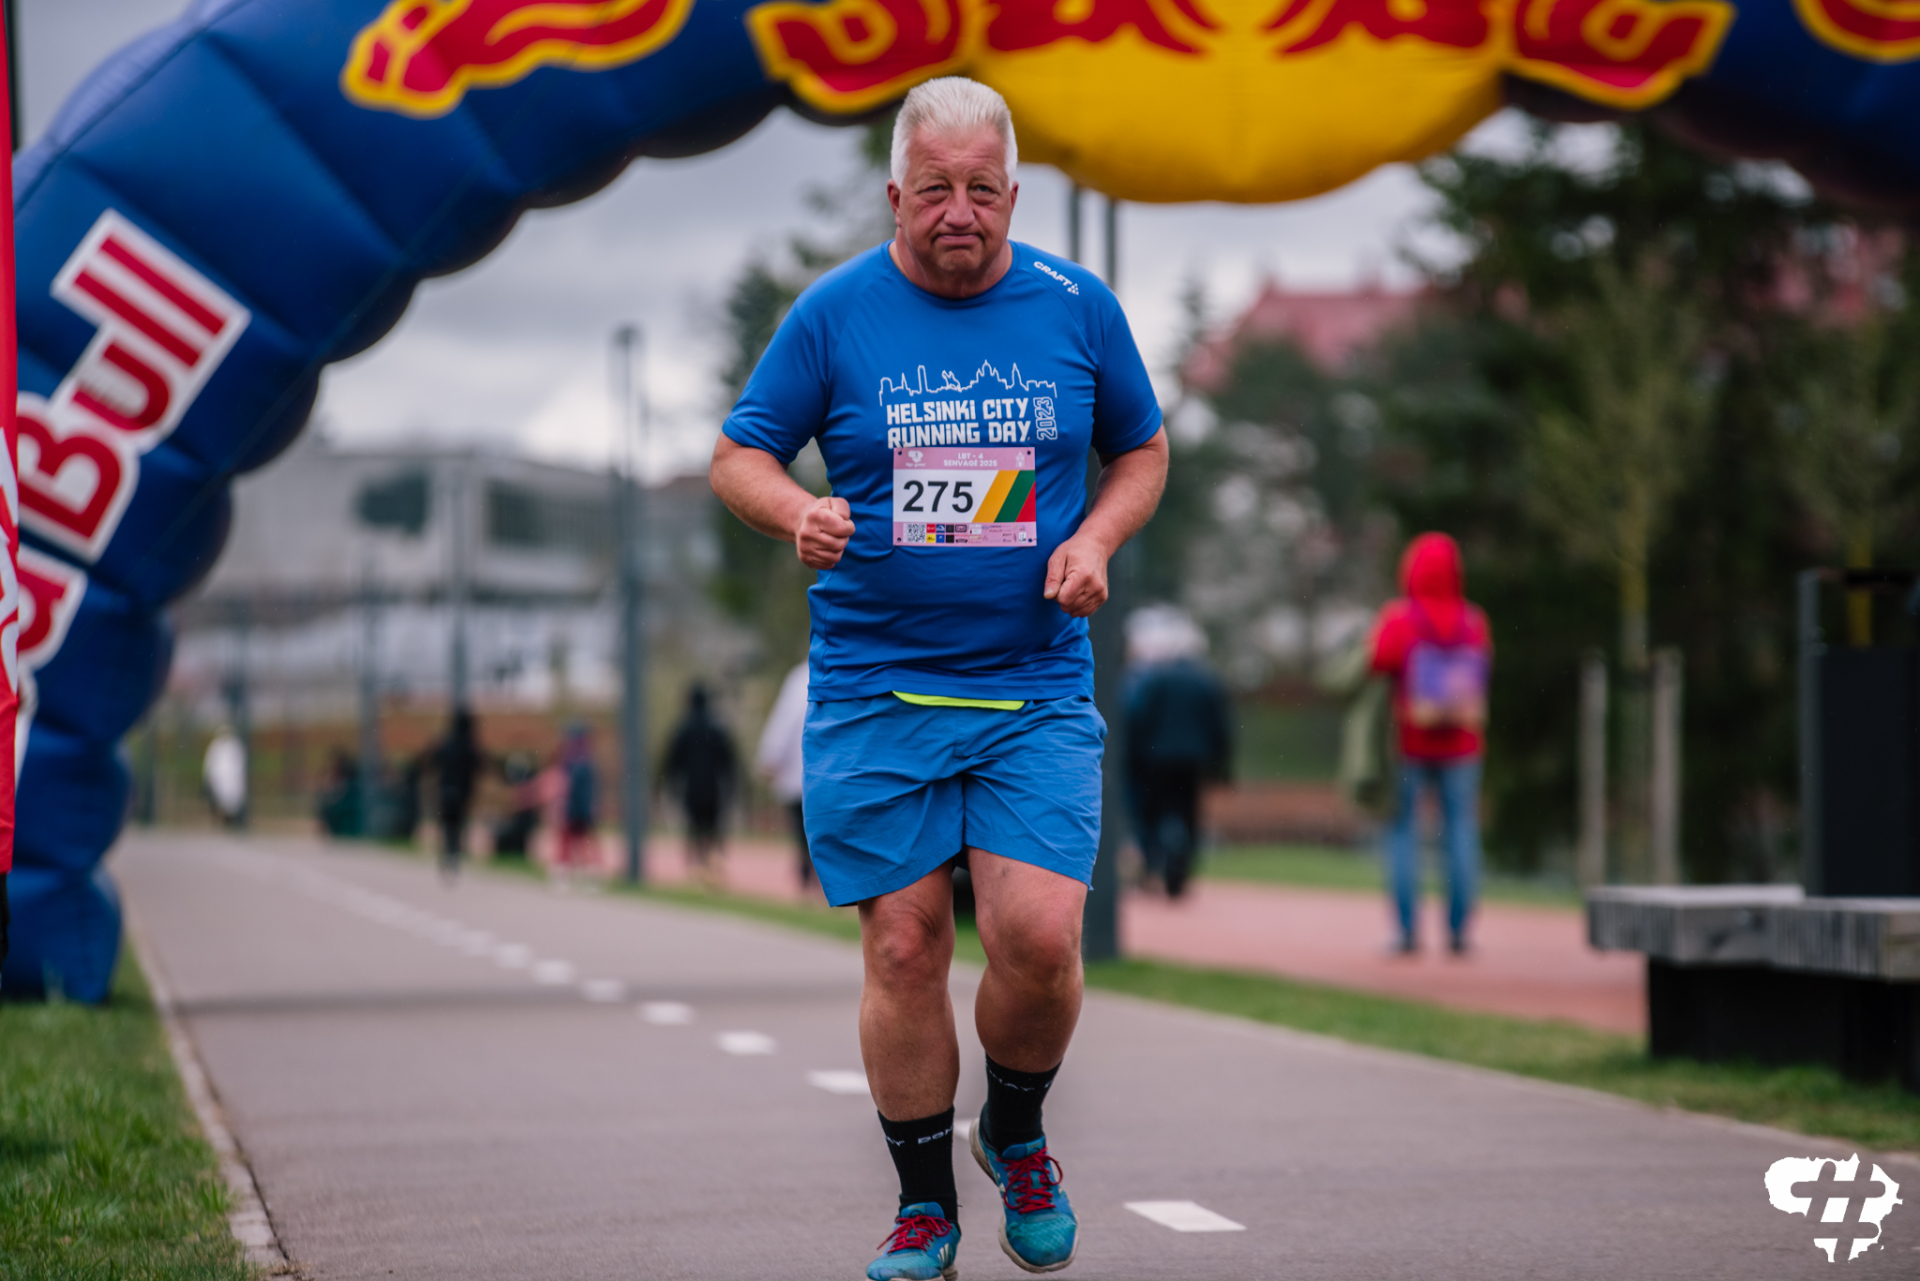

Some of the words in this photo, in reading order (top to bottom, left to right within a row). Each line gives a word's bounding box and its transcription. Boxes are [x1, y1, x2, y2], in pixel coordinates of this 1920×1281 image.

[1033, 260, 1073, 287] CRAFT
[17, 217, 243, 556] Bull
[886, 399, 977, 426] HELSINKI
[982, 397, 1029, 420] CITY
[1032, 396, 1058, 441] 2023
[887, 422, 981, 449] RUNNING
[988, 420, 1031, 443] DAY
[957, 452, 971, 460] LBT
[979, 459, 998, 467] 2025
[902, 479, 974, 514] 275
